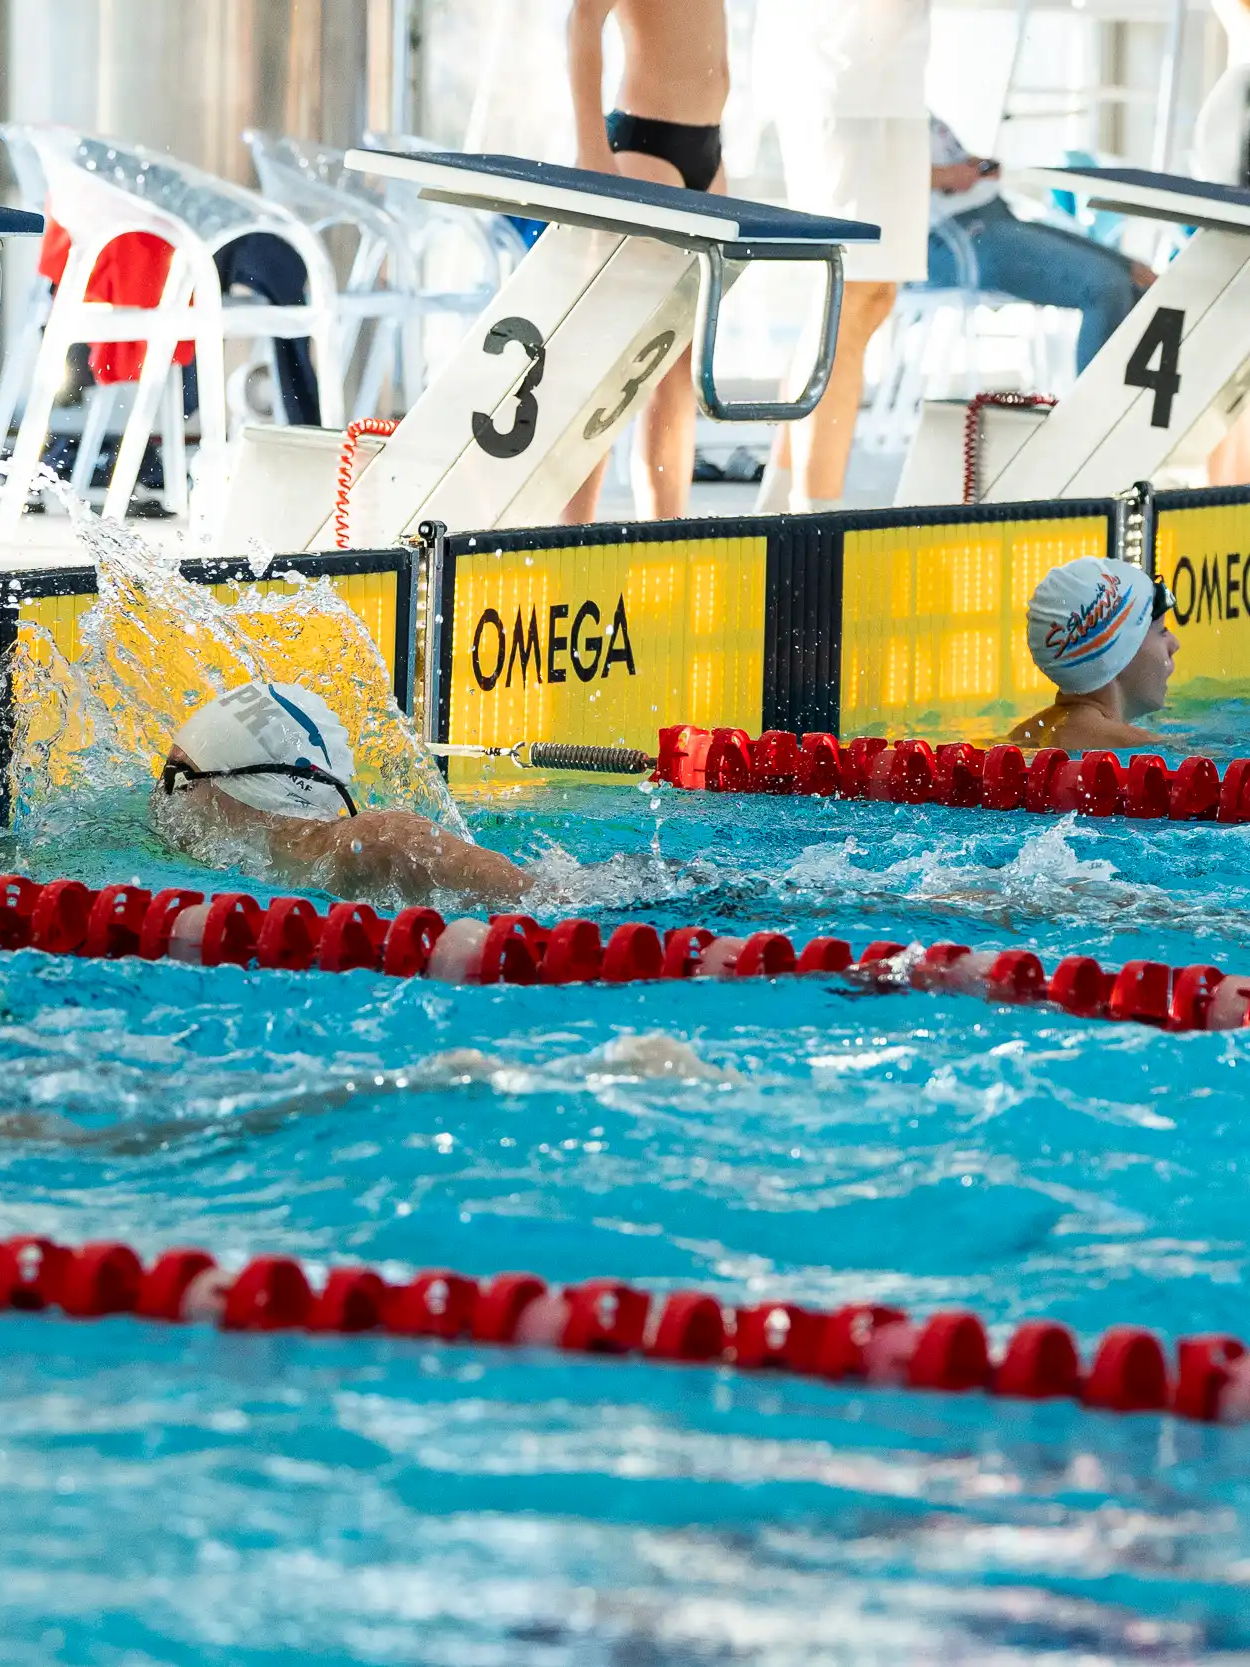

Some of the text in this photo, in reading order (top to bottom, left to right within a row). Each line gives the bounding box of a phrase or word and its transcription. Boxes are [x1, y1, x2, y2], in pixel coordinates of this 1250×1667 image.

[471, 316, 546, 459] 3
[583, 330, 676, 440] 3
[1124, 307, 1185, 428] 4
[472, 592, 636, 692] OMEGA
[1172, 553, 1250, 627] OME
